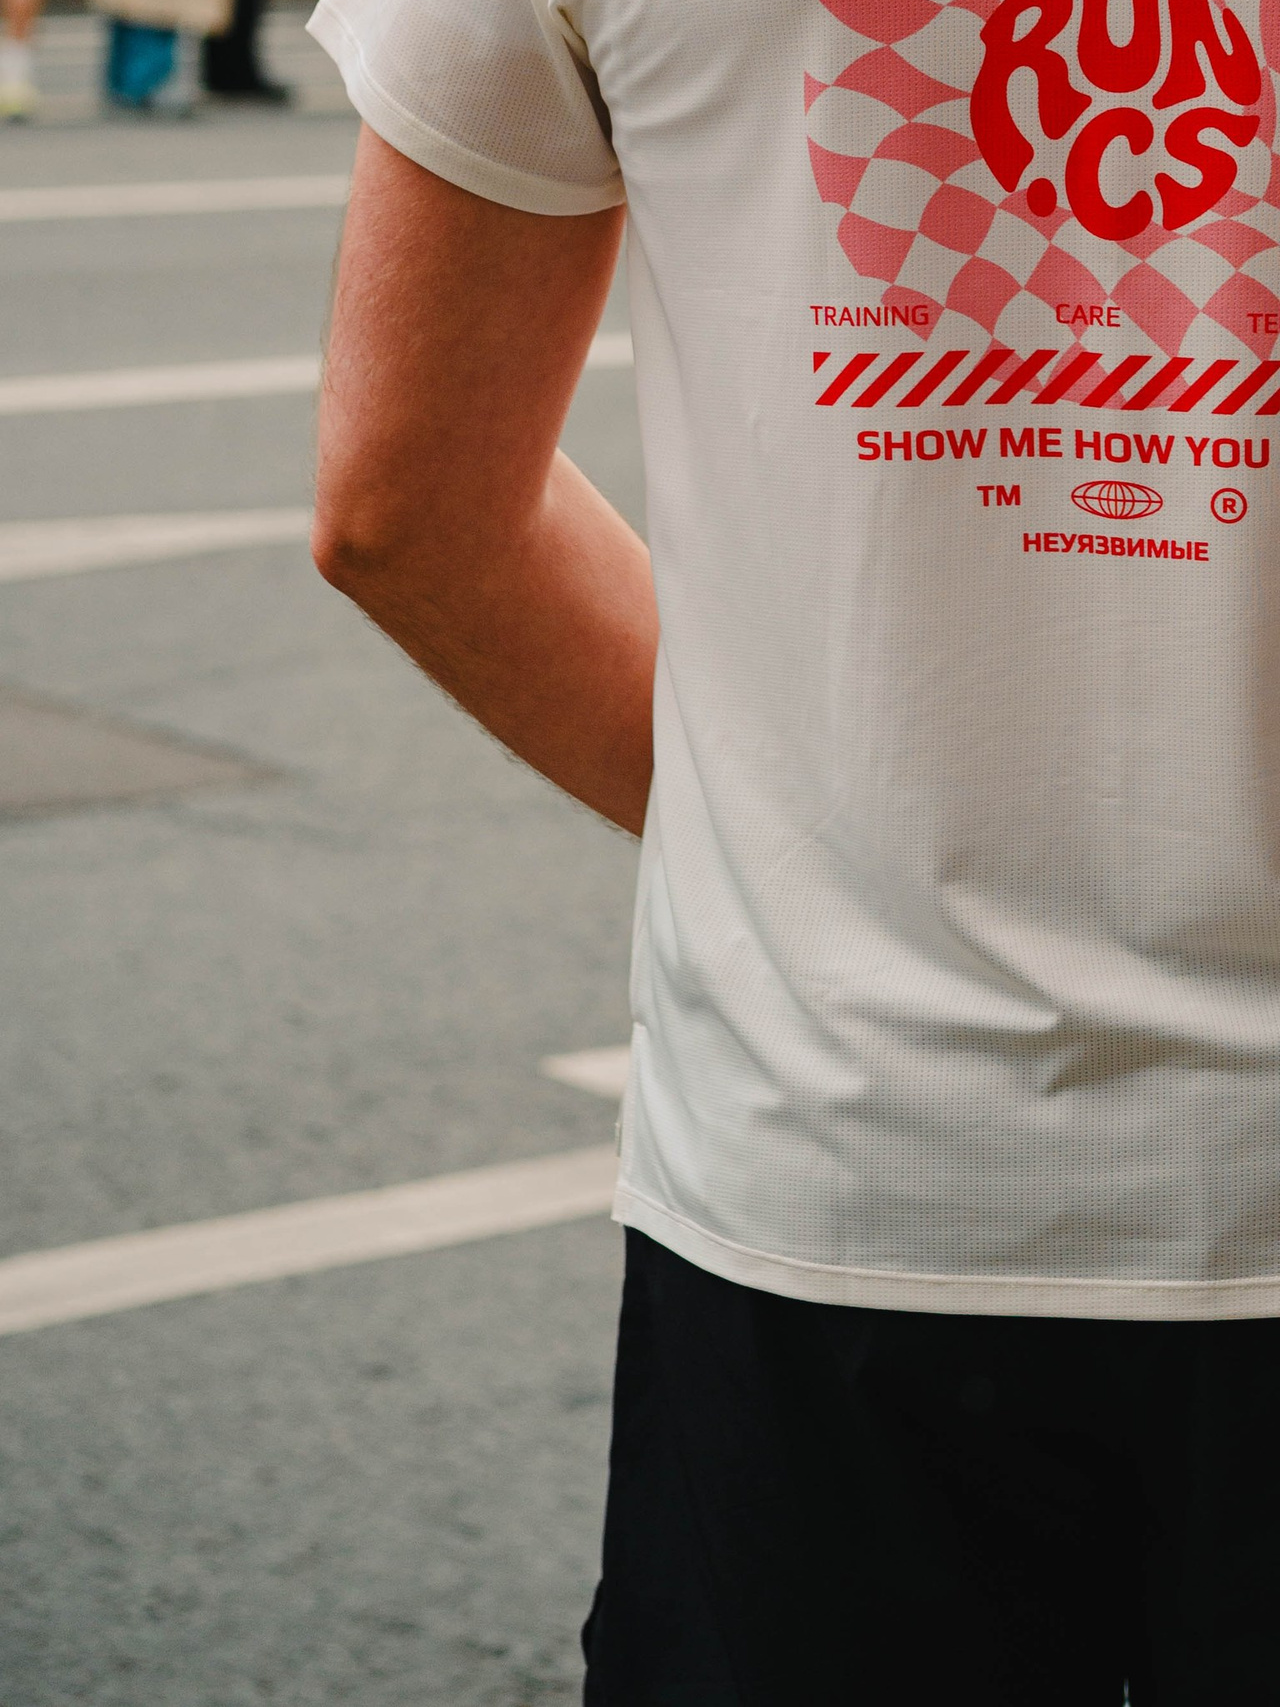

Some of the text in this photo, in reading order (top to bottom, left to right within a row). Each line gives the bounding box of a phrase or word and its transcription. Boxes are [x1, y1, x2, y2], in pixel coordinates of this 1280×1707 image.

[810, 304, 930, 327] TRAINING
[1054, 303, 1122, 328] CARE
[856, 427, 988, 462] SHOW
[999, 426, 1064, 459] ME
[1074, 428, 1176, 465] HOW
[1184, 435, 1271, 470] YOU
[1022, 532, 1210, 562] НЕУЯЗВИМЫЕ
